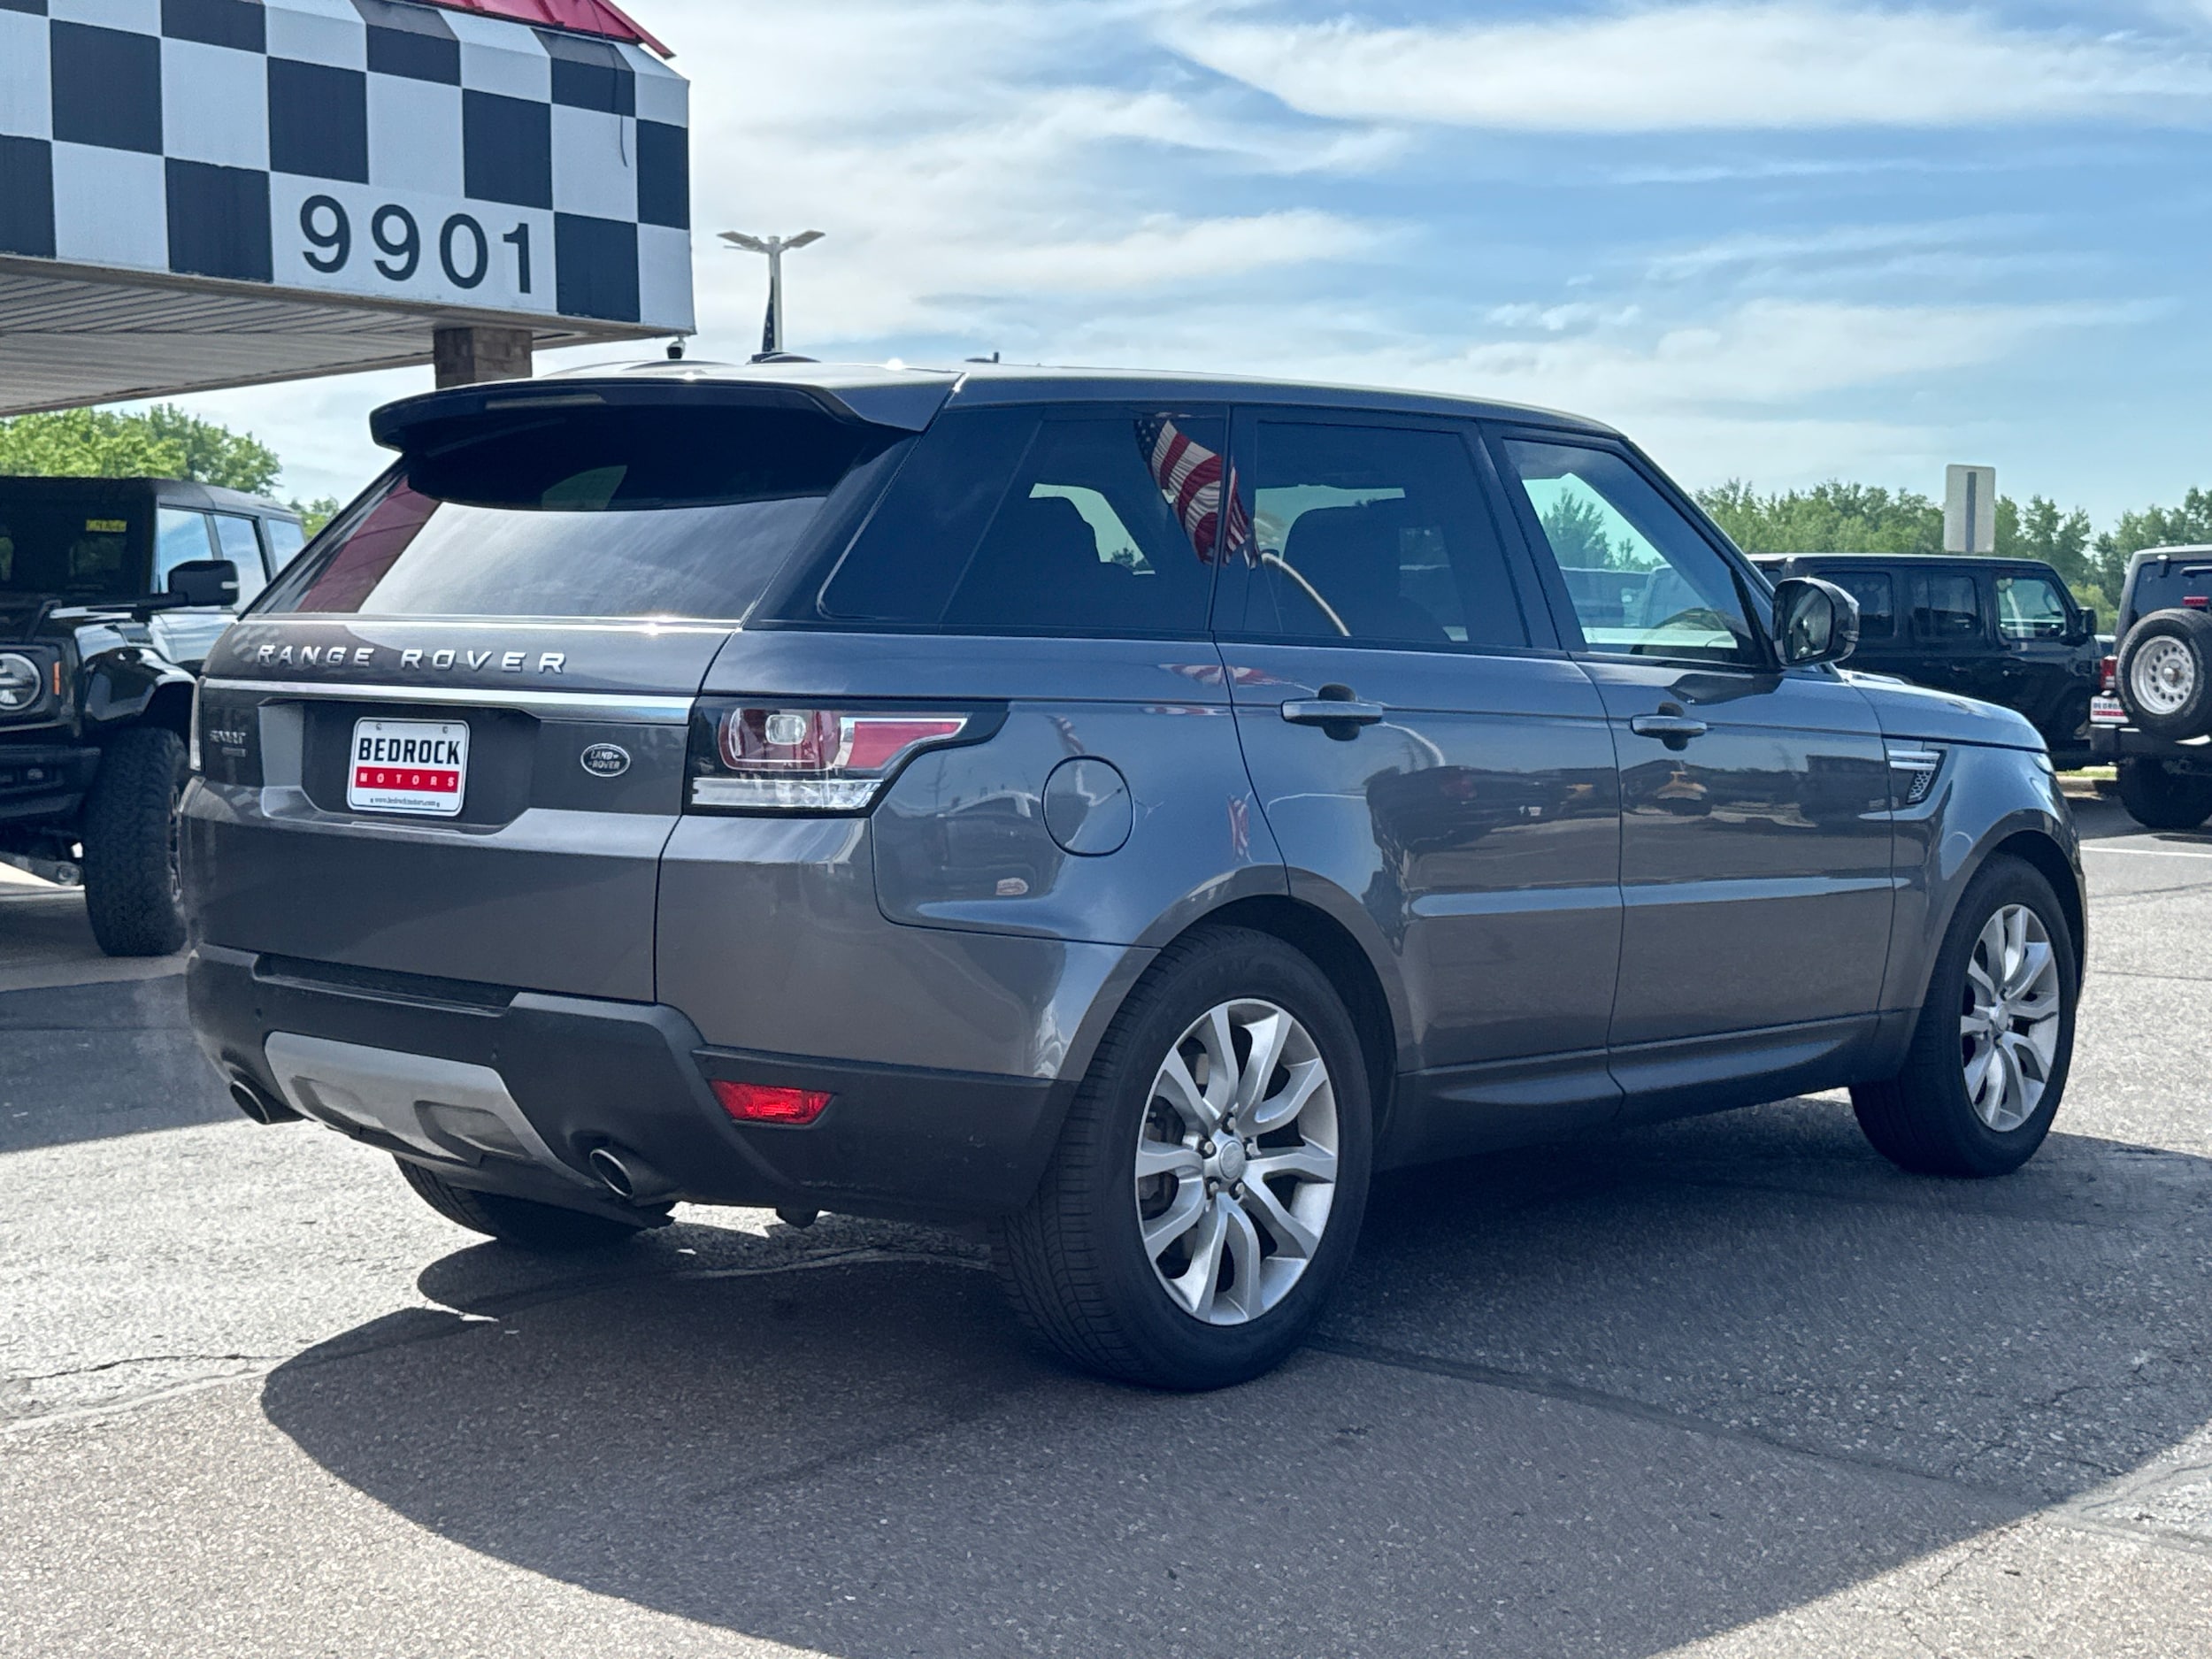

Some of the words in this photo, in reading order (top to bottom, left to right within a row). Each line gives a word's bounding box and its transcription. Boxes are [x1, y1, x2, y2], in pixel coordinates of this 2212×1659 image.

[300, 195, 531, 294] 9901
[257, 644, 375, 668] RANGE
[400, 649, 567, 673] ROVER
[358, 738, 461, 765] BEDROCK
[590, 749, 613, 760] LAND
[592, 759, 620, 770] ROVER
[359, 772, 455, 787] MOTORS
